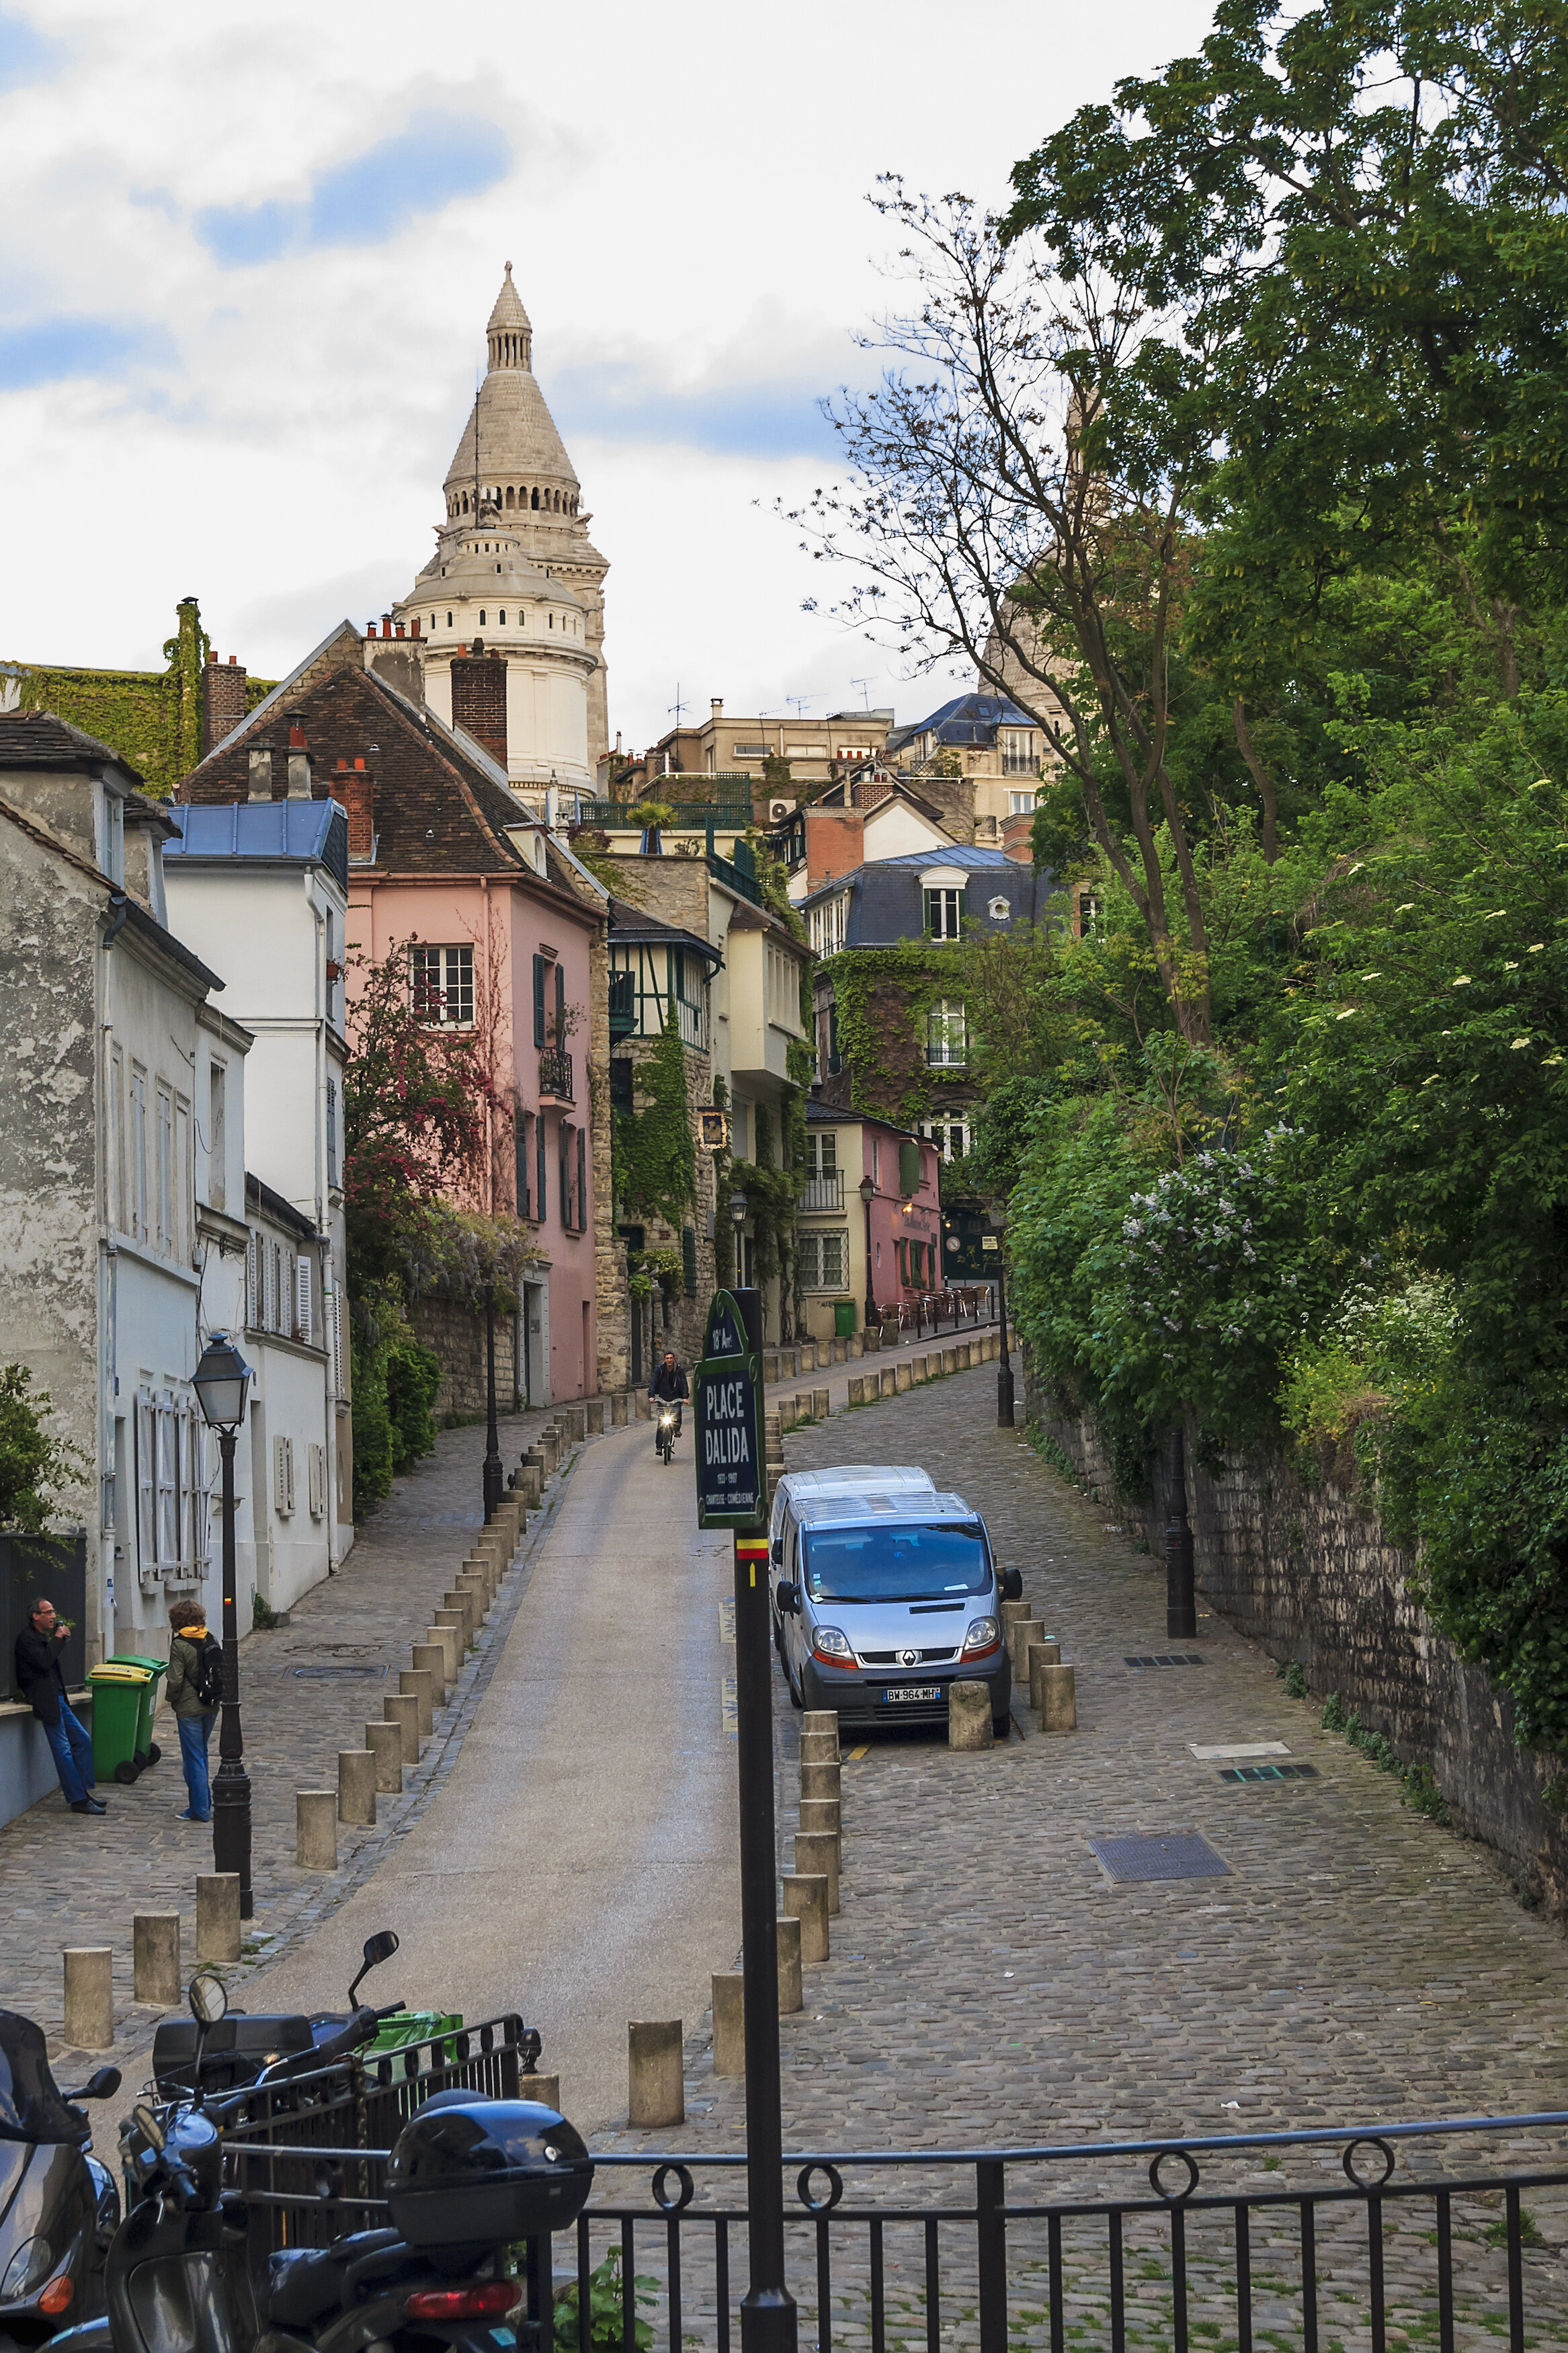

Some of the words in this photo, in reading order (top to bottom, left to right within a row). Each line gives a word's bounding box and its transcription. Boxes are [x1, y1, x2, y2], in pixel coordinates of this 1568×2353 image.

[706, 1382, 745, 1421] PLACE
[705, 1427, 749, 1465] DALIDA
[889, 1689, 935, 1700] BW-964-MH
